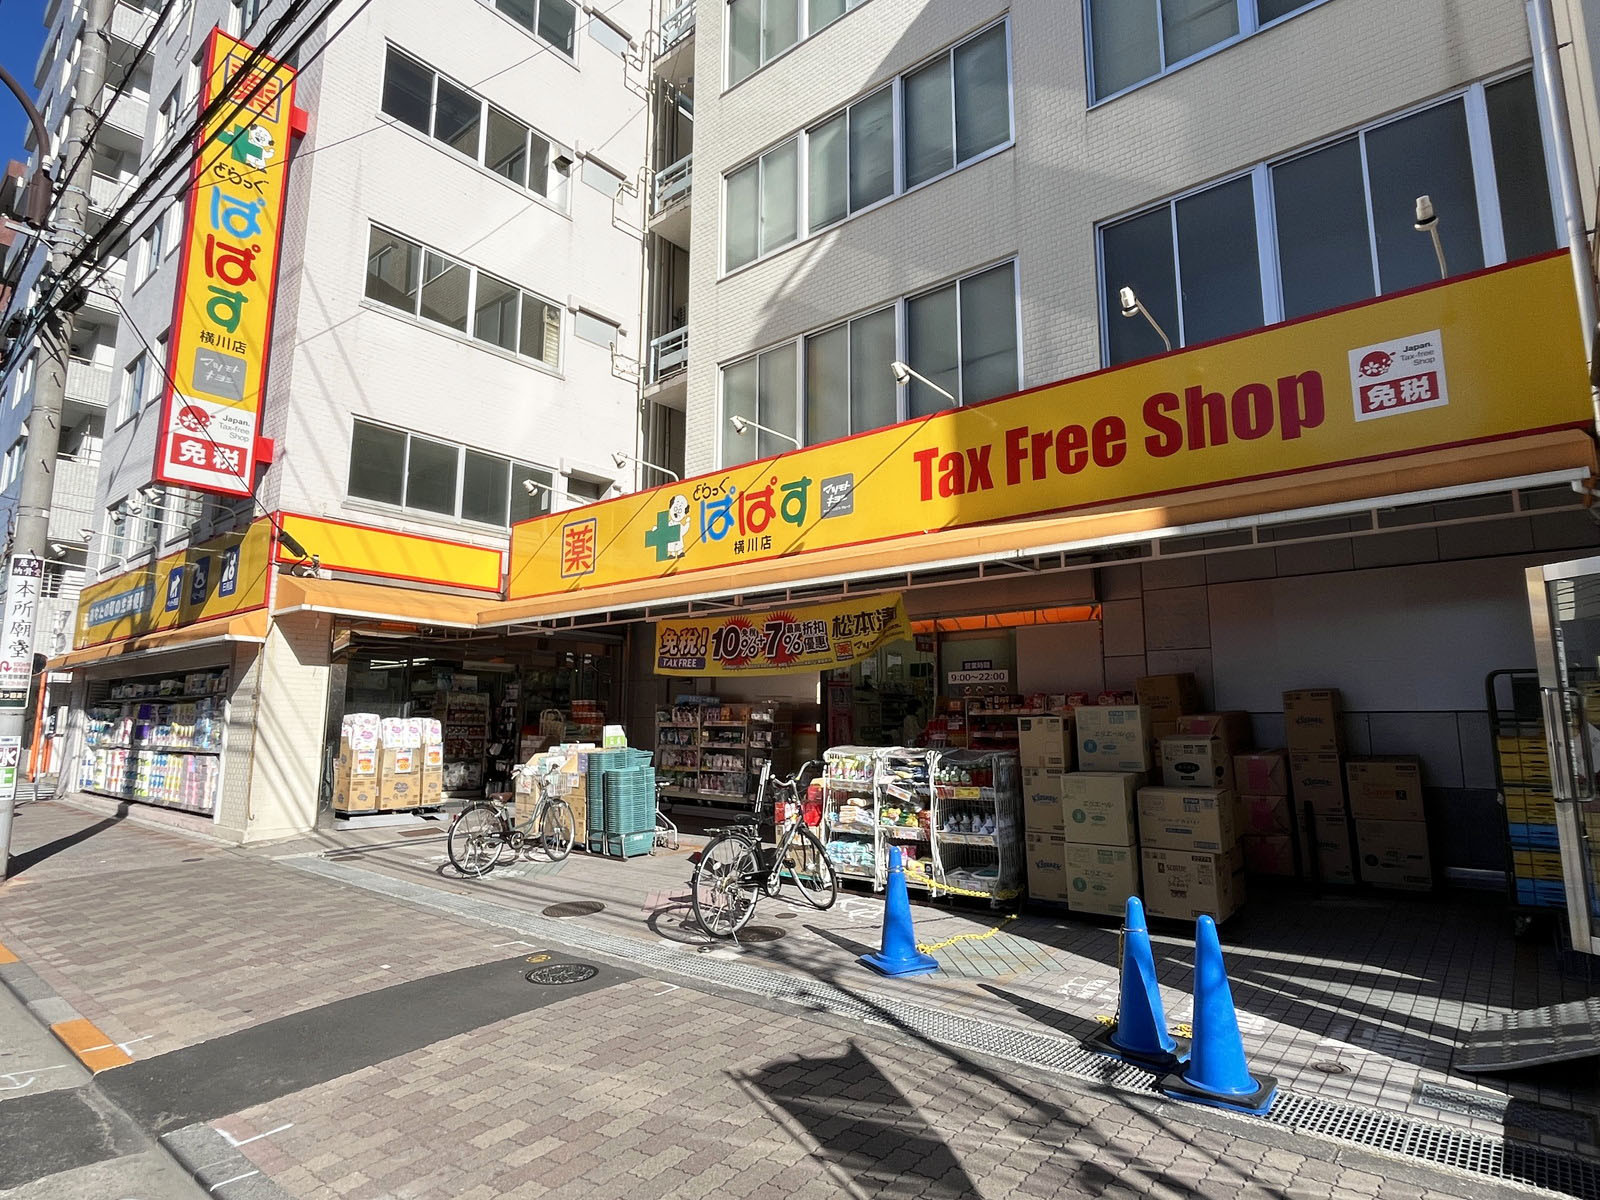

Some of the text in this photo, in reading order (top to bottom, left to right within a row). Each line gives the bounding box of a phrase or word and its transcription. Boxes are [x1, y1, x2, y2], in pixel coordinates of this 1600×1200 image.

[200, 330, 247, 354] 横川店
[200, 357, 241, 373] マツモト
[1400, 350, 1435, 362] Tax-free
[1413, 357, 1436, 367] Shop
[1367, 376, 1432, 410] 免税
[229, 432, 250, 443] Shop
[913, 369, 1325, 502] Tax Free Shop
[178, 440, 240, 472] 免税
[566, 525, 593, 573] 薬
[734, 535, 772, 555] 横川店
[9, 580, 36, 659] 本所廟堂
[678, 658, 698, 668] FREE
